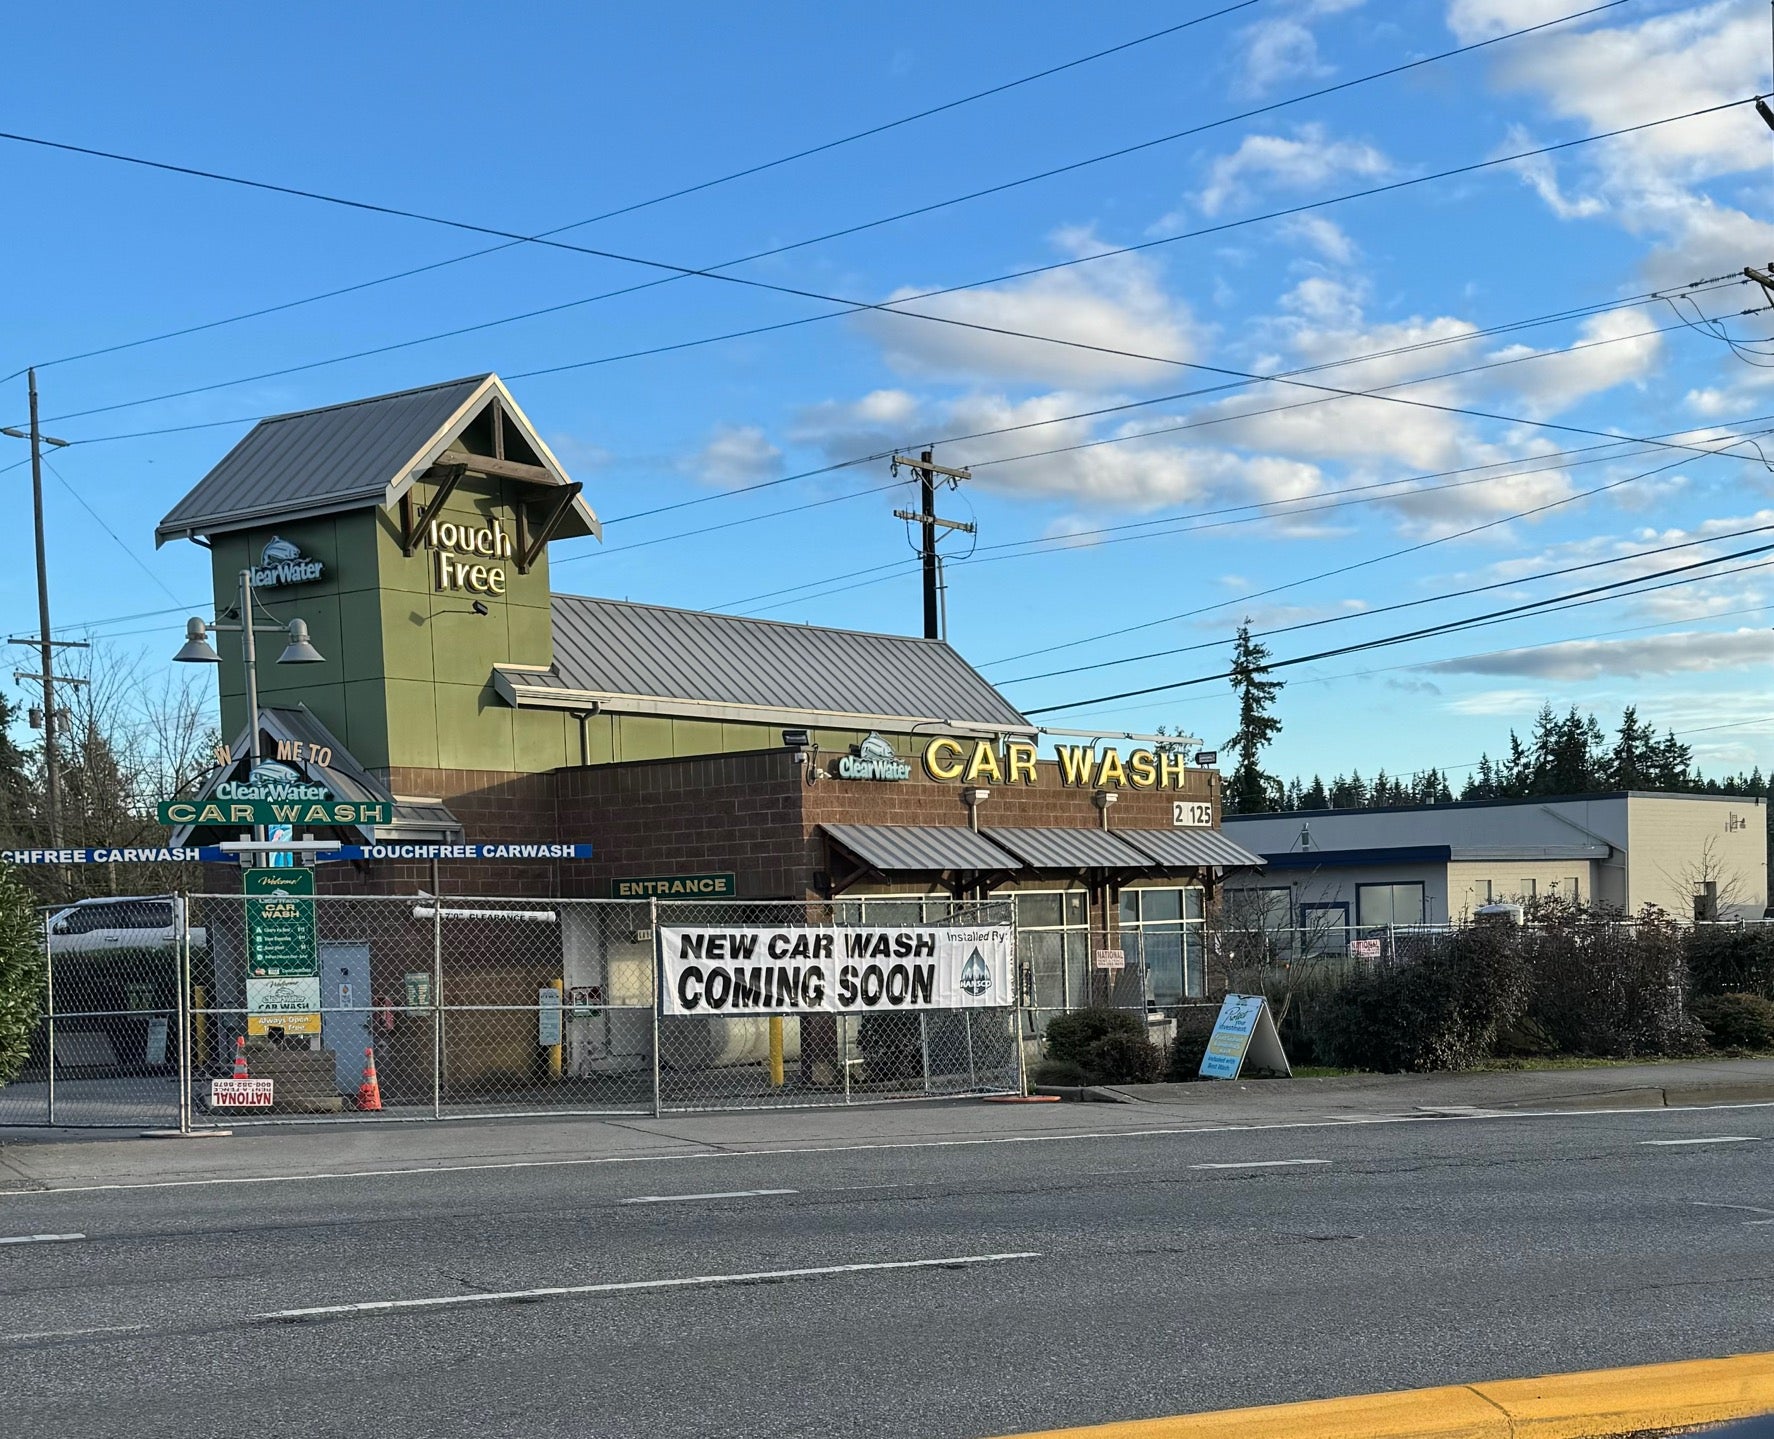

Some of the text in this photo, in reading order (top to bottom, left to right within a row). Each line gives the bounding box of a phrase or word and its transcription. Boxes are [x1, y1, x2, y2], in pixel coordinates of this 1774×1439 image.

[249, 562, 323, 587] learWater
[440, 552, 506, 593] Free
[309, 743, 332, 767] TO
[923, 736, 1185, 790] CAR WASH
[838, 756, 911, 780] ClearWater
[216, 783, 329, 800] ClearWater
[167, 804, 383, 823] CAR WASH
[93, 847, 199, 863] CARWASH
[360, 844, 575, 858] TOUCHFREE CARWASH
[620, 878, 726, 896] ENTRANCE
[261, 910, 299, 918] WASH
[468, 913, 526, 922] CLEARANCE
[947, 931, 989, 942] Installed
[680, 932, 935, 960] NEW CAR WASH
[678, 964, 935, 1010] COMING SOON
[213, 1092, 271, 1104] NATIONAL
